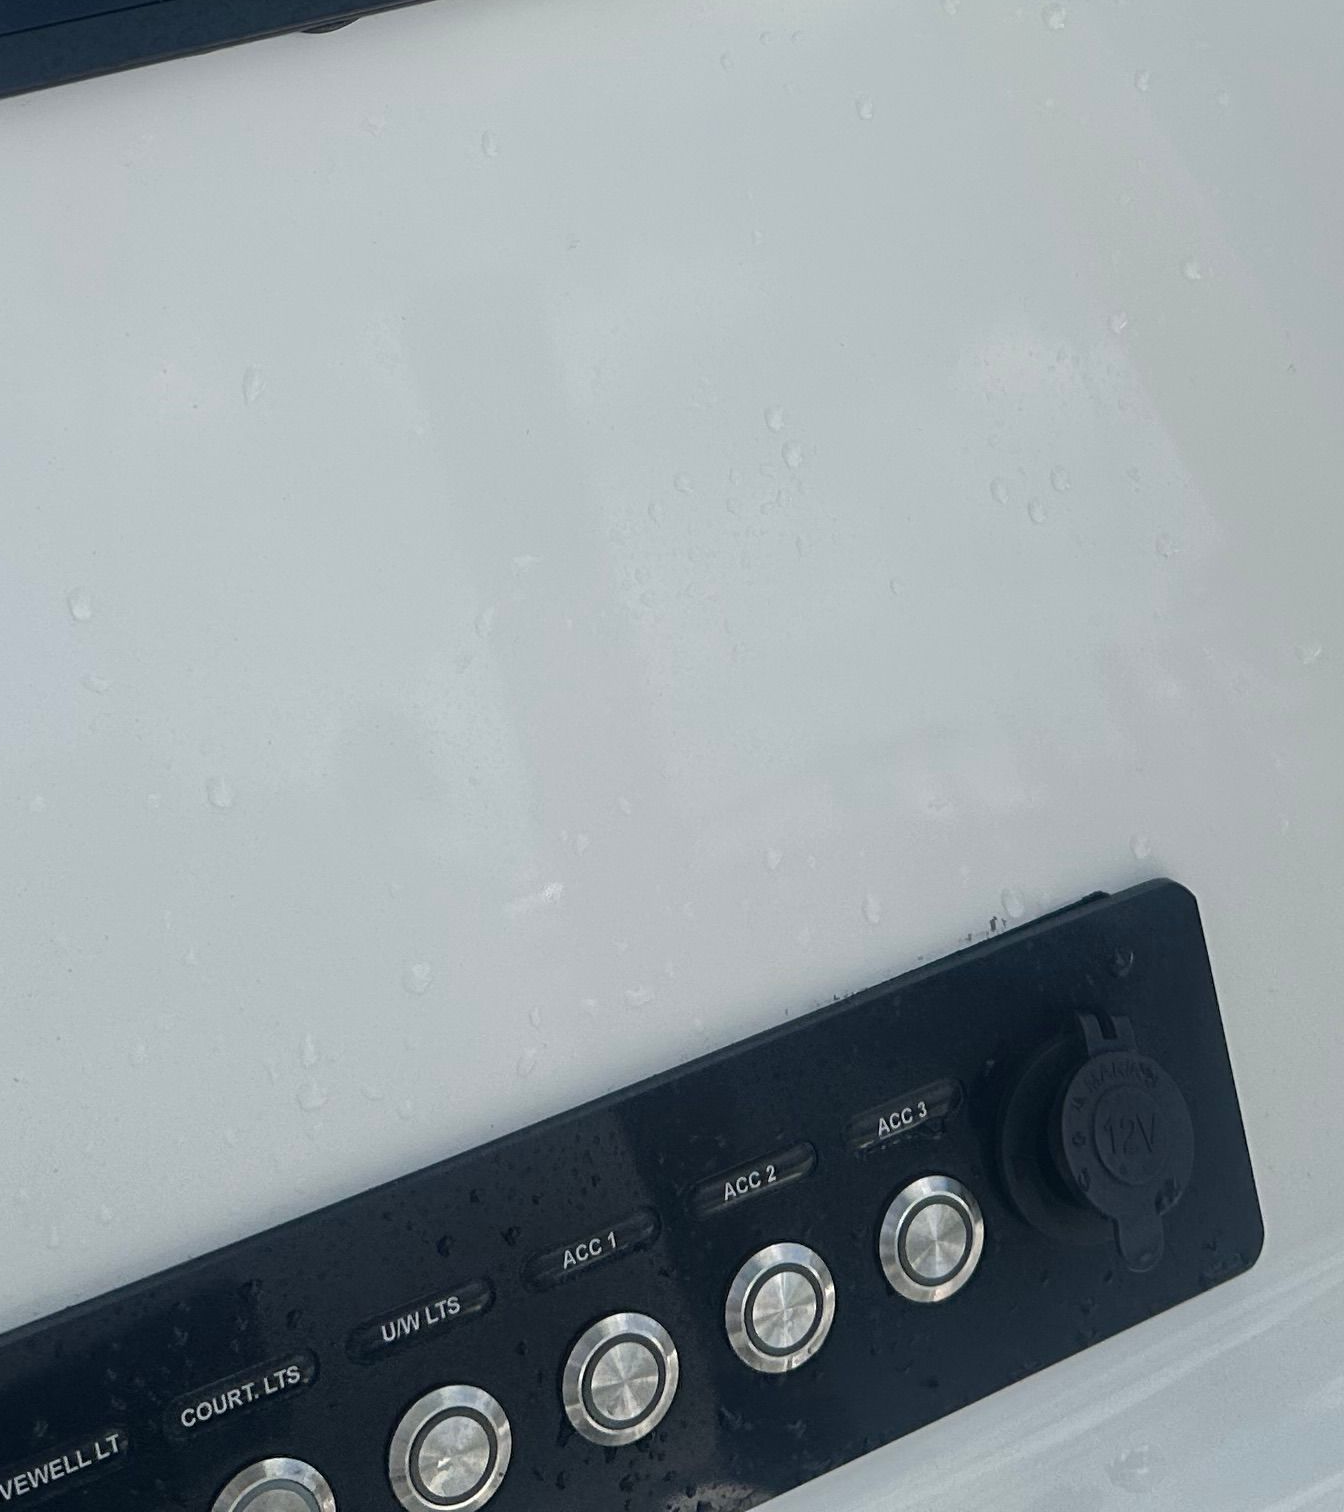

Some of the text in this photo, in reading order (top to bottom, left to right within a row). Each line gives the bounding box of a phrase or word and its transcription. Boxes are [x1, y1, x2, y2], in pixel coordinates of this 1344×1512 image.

[878, 1101, 928, 1137] ACC 3
[724, 1164, 777, 1201] ACC 2
[563, 1231, 616, 1270] ACC 1
[381, 1296, 461, 1342] U/W LTS
[181, 1365, 301, 1427] COURT. LTS
[94, 1433, 119, 1460] LT
